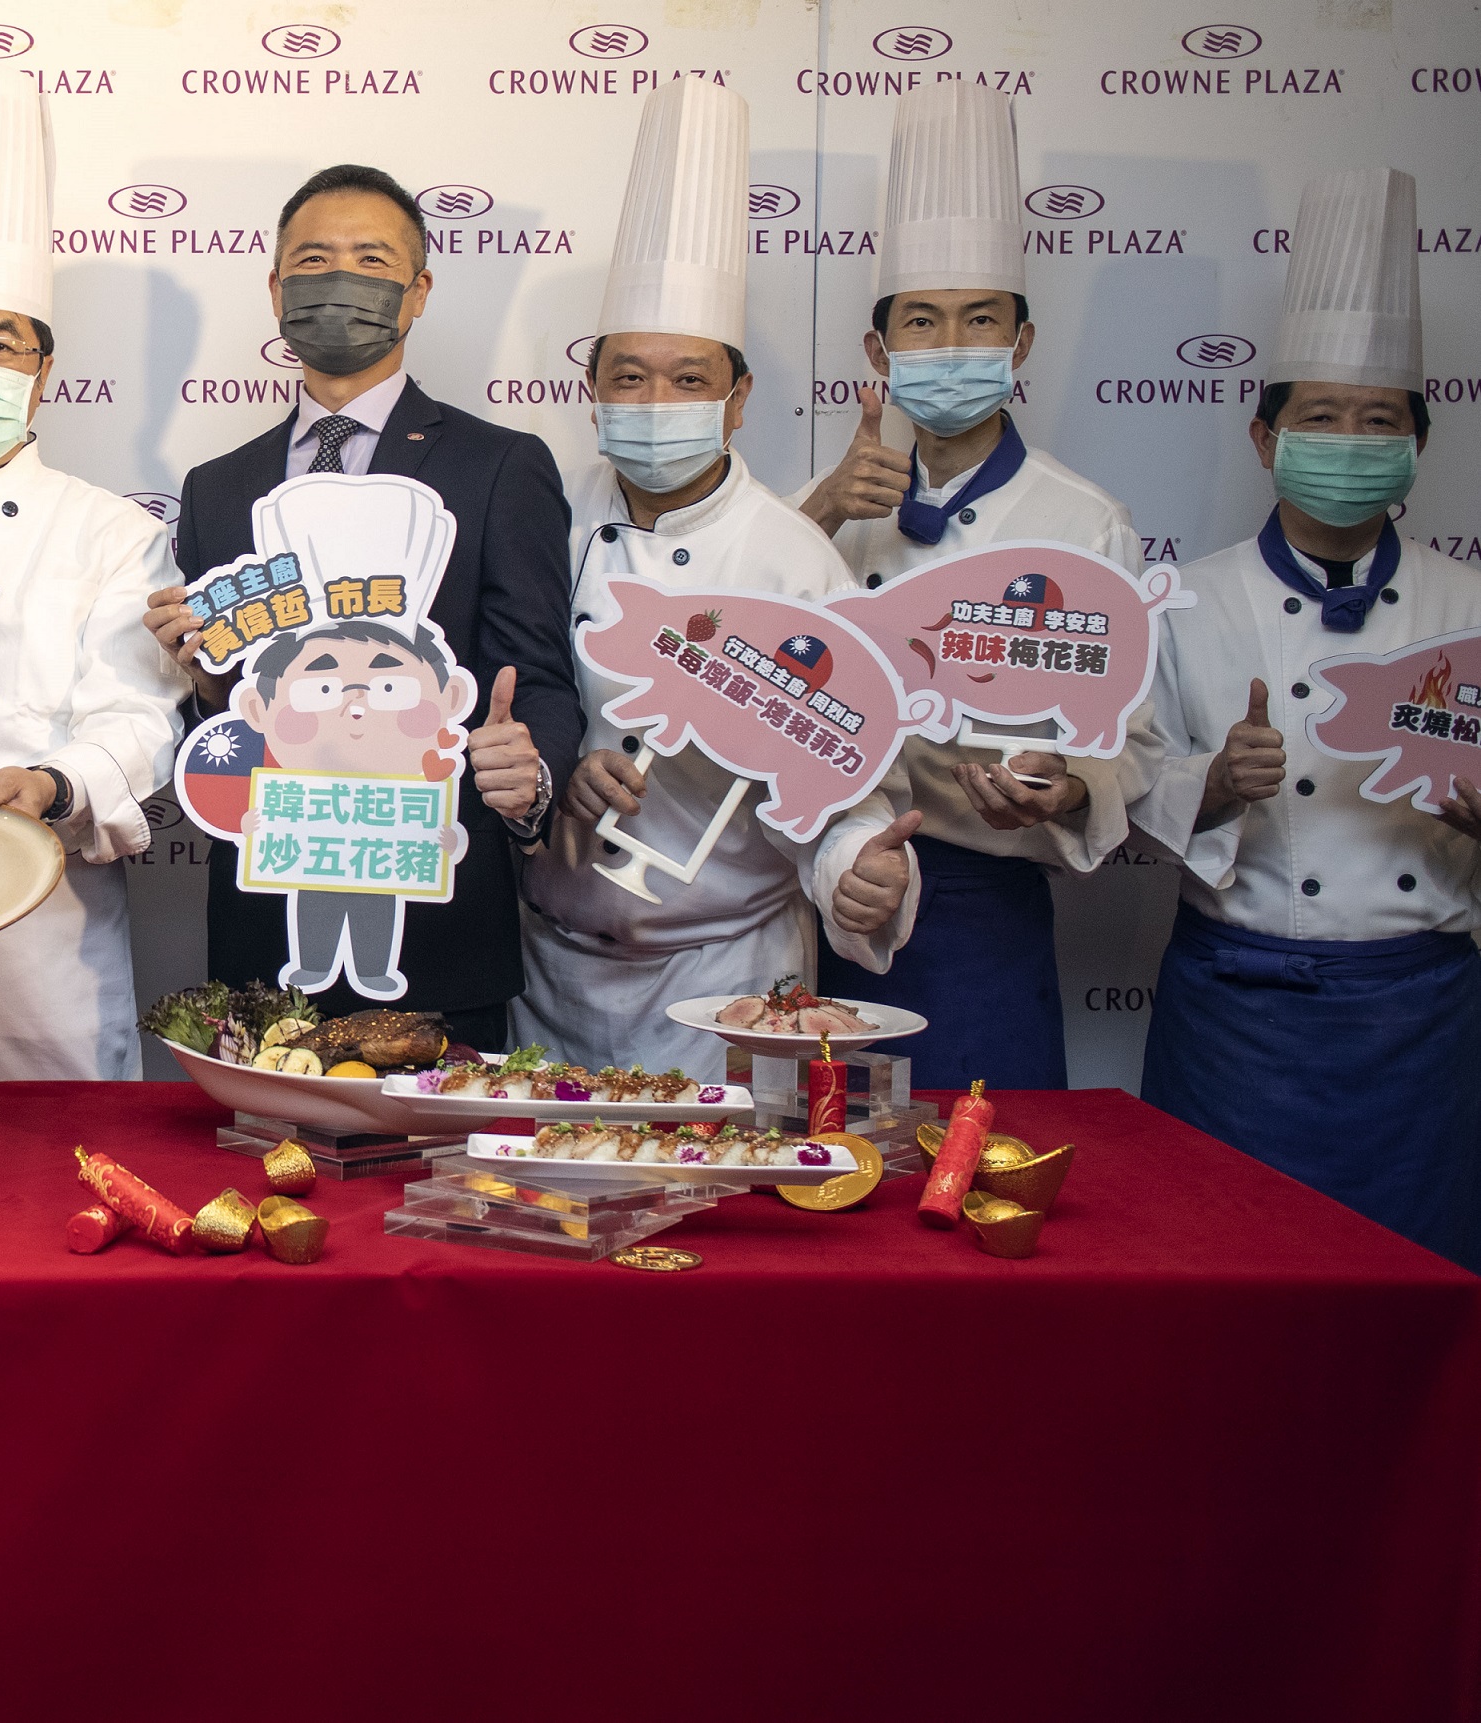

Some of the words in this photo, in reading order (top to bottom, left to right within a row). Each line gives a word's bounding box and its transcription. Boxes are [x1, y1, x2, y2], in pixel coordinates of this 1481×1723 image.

[182, 70, 309, 94] CROWNE
[490, 70, 616, 94] CROWNE
[1101, 70, 1230, 94] CROWNE
[51, 229, 156, 254] ROWNE
[487, 379, 595, 404] CROWN
[1096, 380, 1224, 404] CROWNE
[327, 578, 403, 617] 市長
[952, 601, 1035, 628] 功夫主廚
[1044, 609, 1108, 634] 李安忠
[941, 629, 1108, 675] 辣味梅花豬
[722, 636, 809, 698] 行政總主廚
[807, 690, 865, 734] 周烈成
[1391, 703, 1481, 746] 炙燒松
[261, 779, 441, 830] 韓式起司
[257, 832, 441, 884] 炒五花豬
